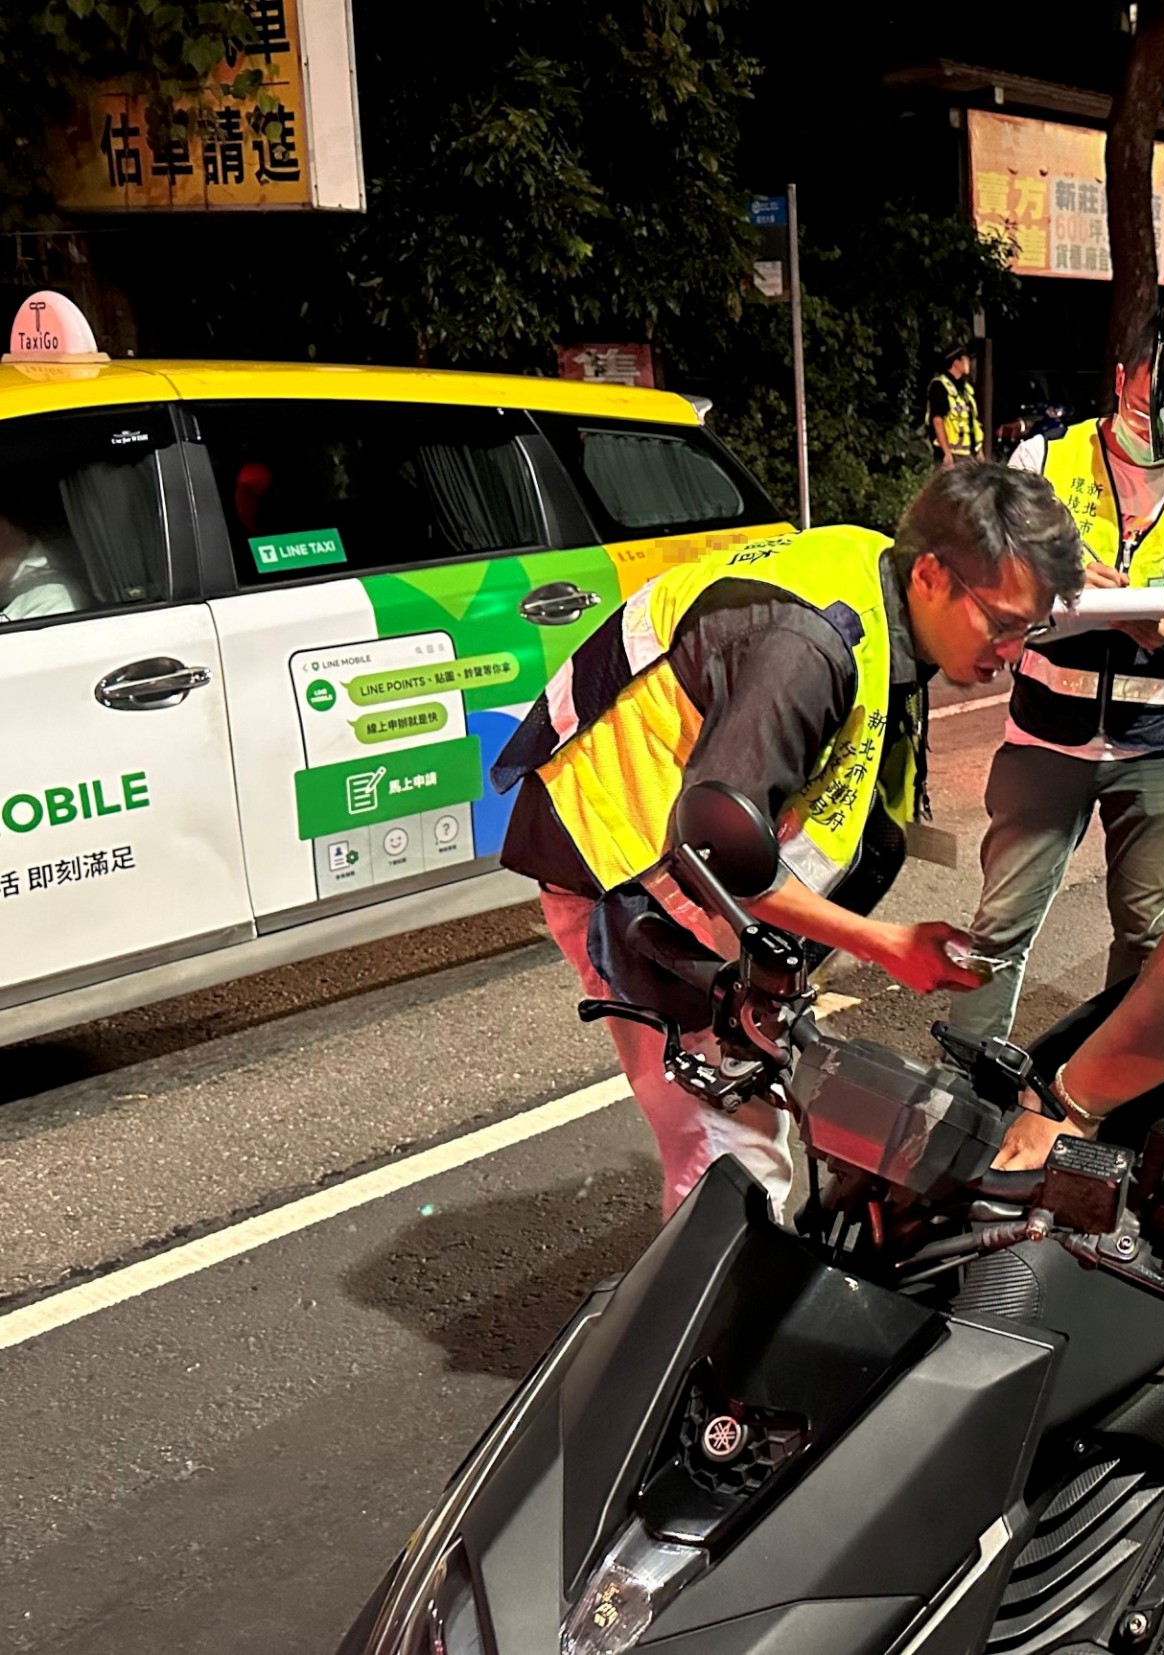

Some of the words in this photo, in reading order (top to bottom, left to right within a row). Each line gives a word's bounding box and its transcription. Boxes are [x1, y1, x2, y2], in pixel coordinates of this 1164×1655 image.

[18, 332, 58, 350] TaxiGo
[279, 543, 309, 558] LINE
[308, 540, 336, 554] TAXI
[322, 658, 341, 669] LINE
[341, 654, 372, 665] MOBILE
[360, 683, 386, 697] LINE
[366, 711, 439, 735] 線上申辦就是快
[389, 771, 438, 795] 馬上申請
[0, 771, 150, 834] OBILE
[28, 845, 136, 891] 即刻滿足
